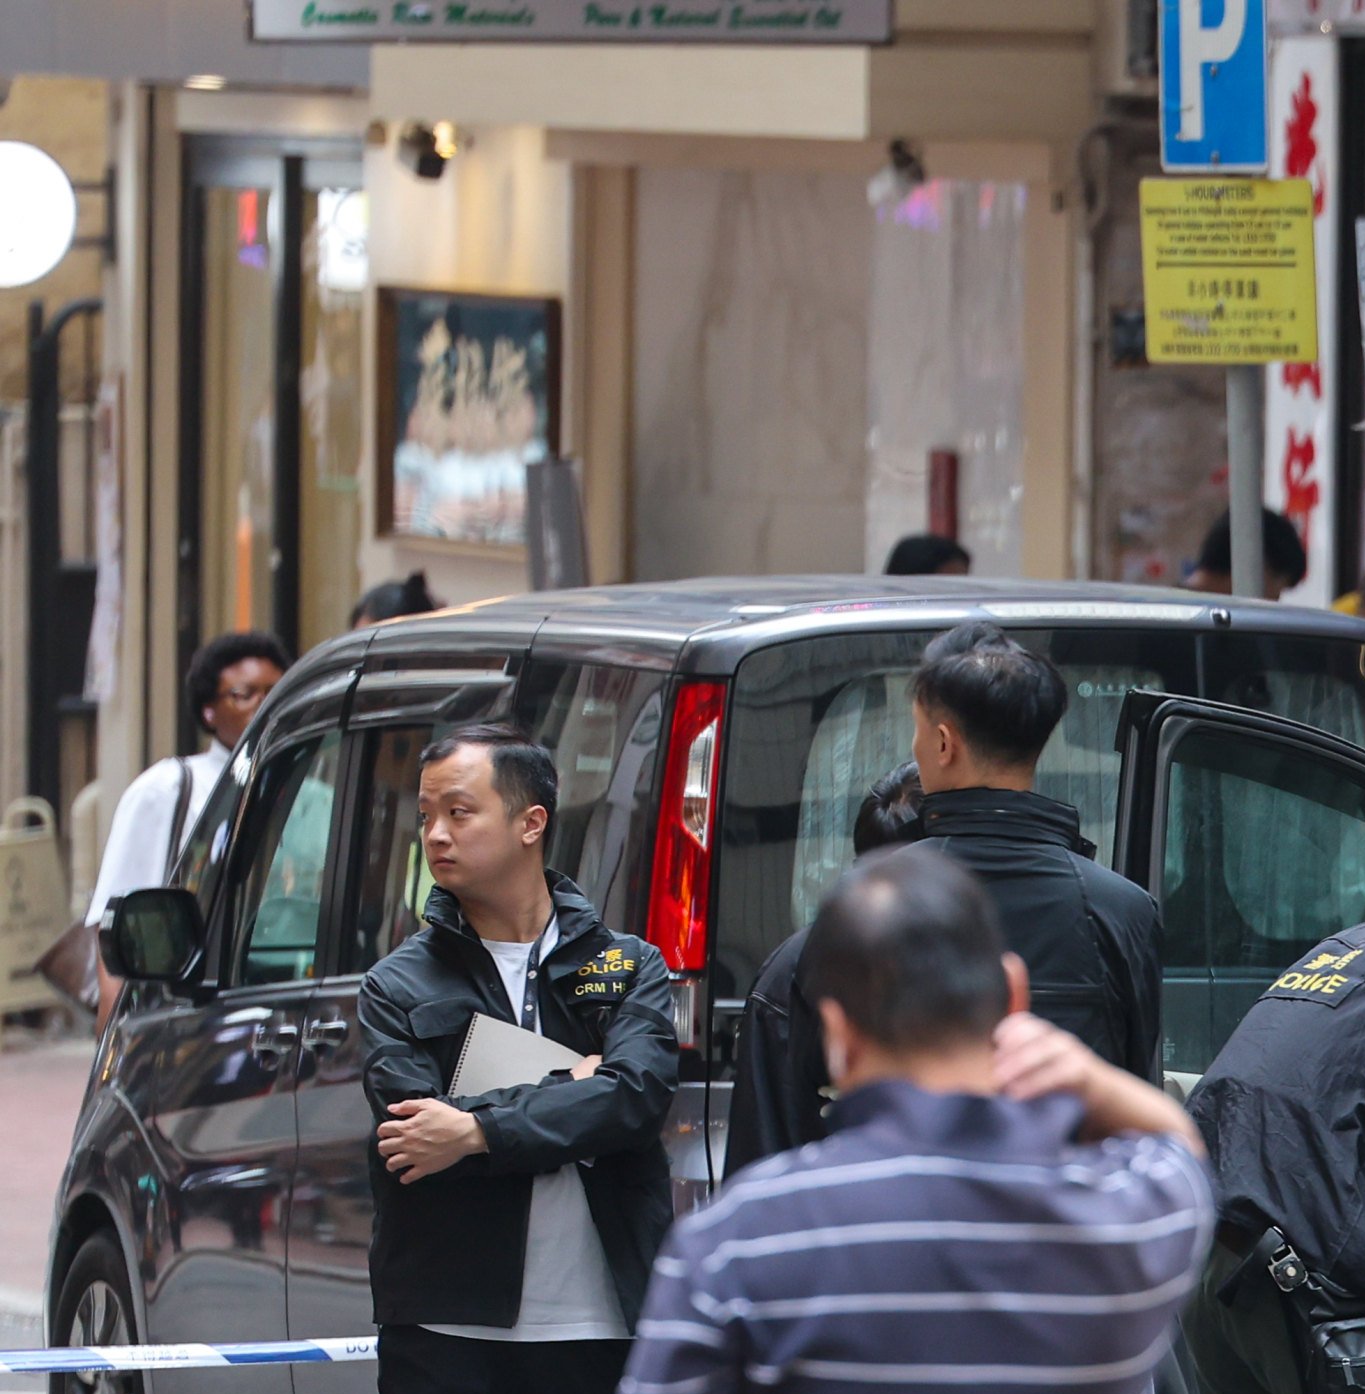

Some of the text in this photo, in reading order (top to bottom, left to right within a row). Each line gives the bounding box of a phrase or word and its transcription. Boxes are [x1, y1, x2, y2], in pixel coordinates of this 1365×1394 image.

[1179, 0, 1247, 141] P
[577, 959, 635, 977] OLICE
[574, 981, 607, 996] CRM
[1267, 972, 1349, 994] POLICE
